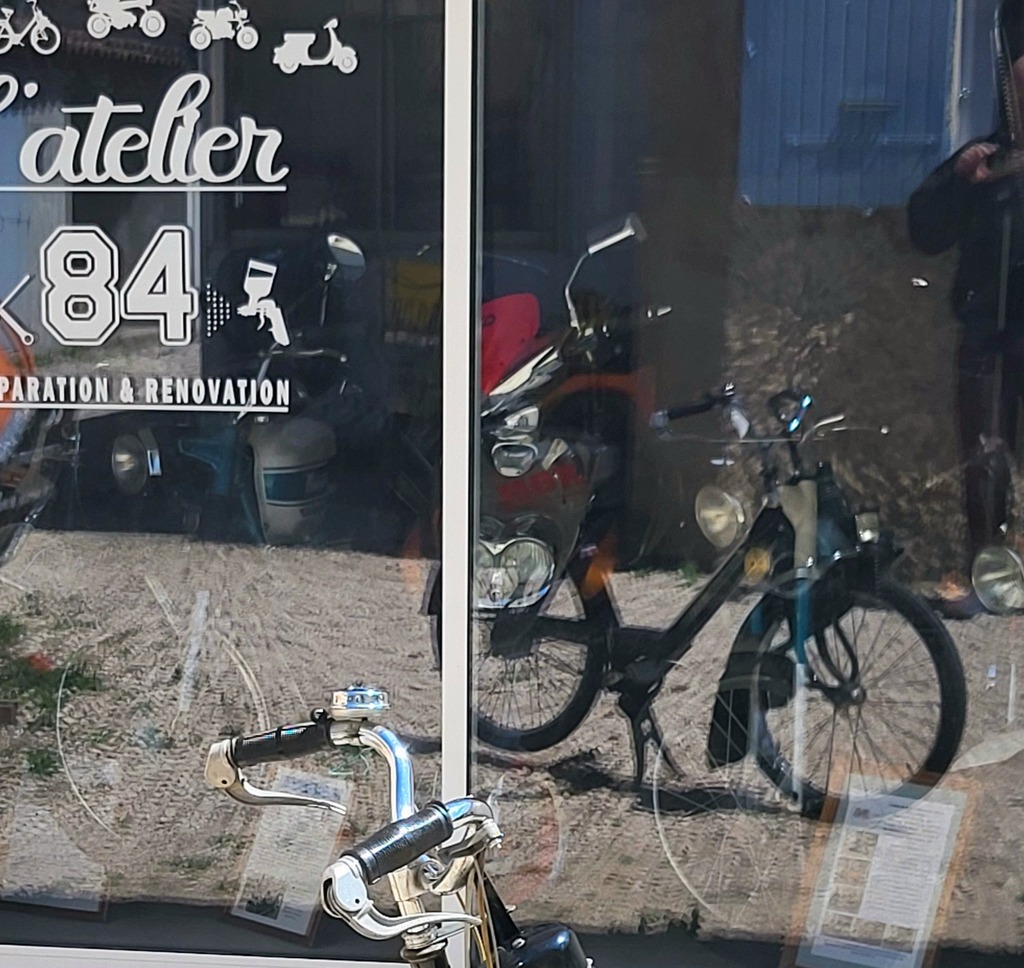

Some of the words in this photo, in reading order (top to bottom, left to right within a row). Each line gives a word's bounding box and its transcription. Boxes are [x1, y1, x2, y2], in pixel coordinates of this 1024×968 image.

[40, 225, 199, 346] 84
[120, 378, 134, 404] &
[145, 378, 290, 406] RENOVATION
